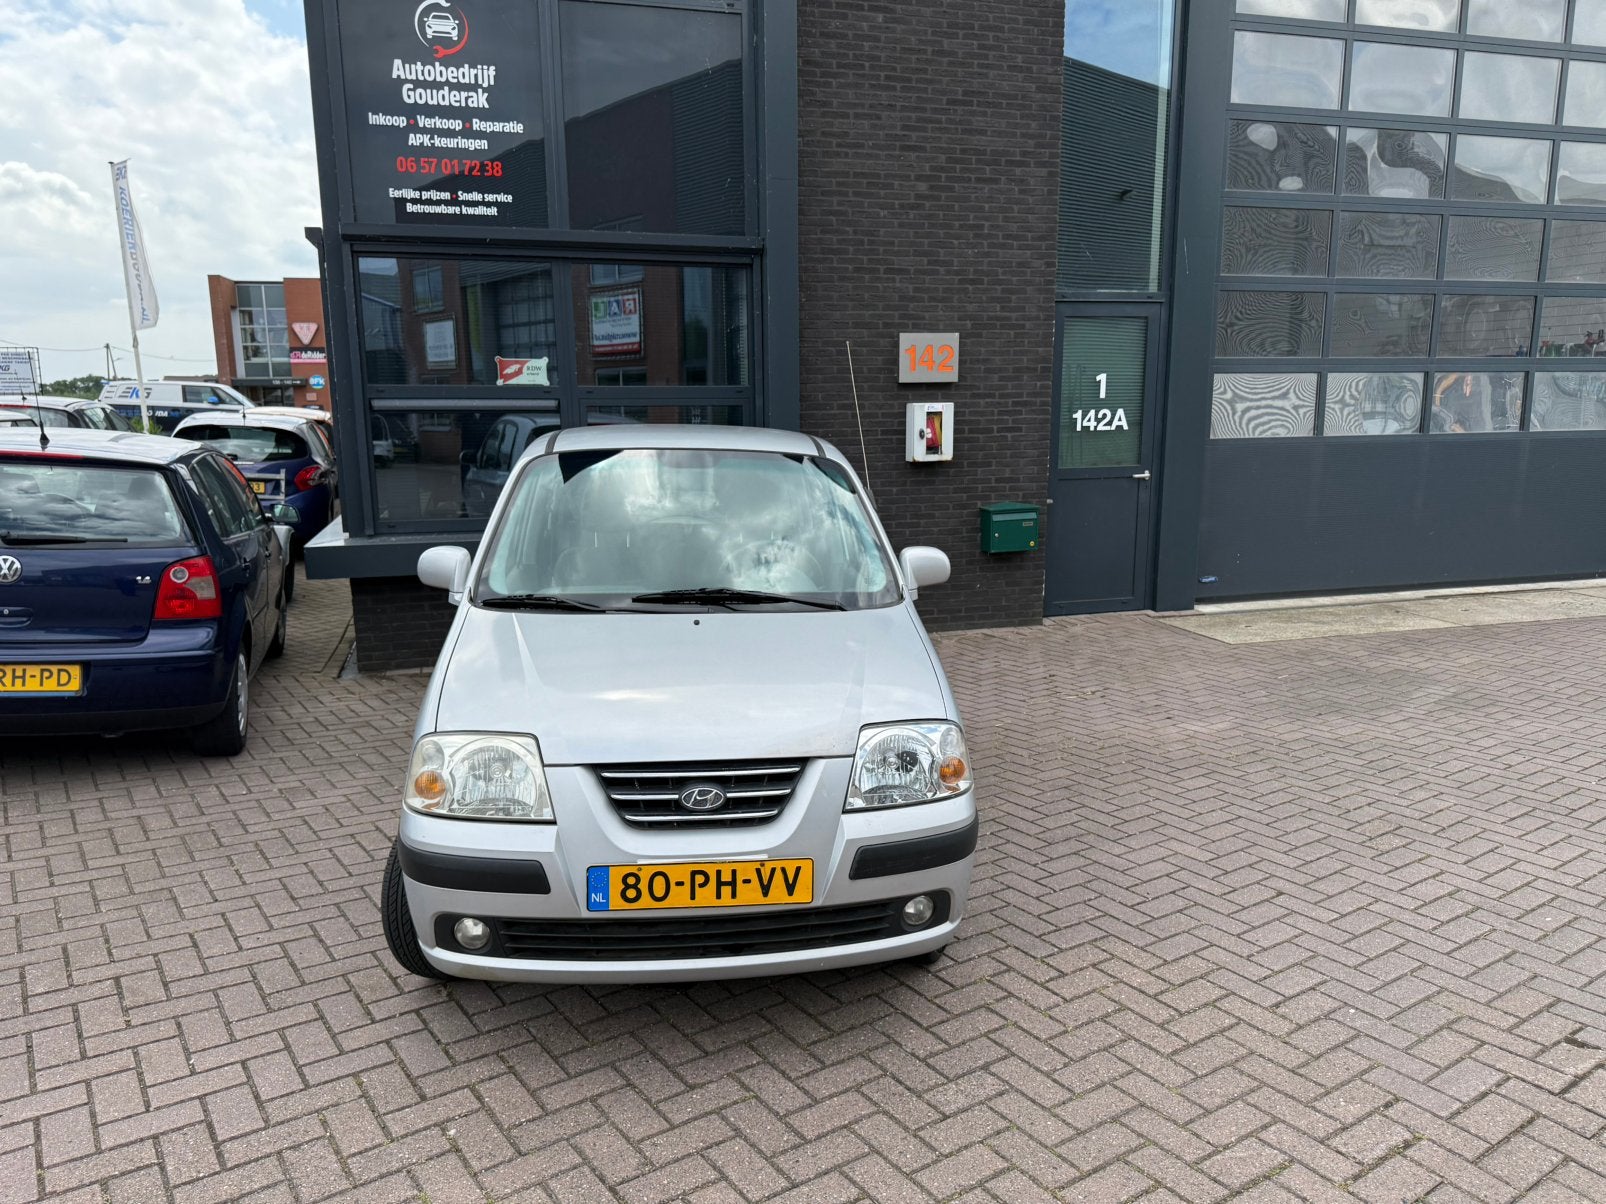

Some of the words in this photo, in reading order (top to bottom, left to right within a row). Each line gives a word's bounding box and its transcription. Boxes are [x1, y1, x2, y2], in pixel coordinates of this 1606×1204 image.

[392, 59, 496, 87] Autobedrijf
[402, 83, 489, 108] Gouderak
[368, 112, 407, 128] Inkoop
[416, 115, 463, 131] Verkoop
[472, 118, 524, 133] Reparatie
[408, 133, 488, 150] APK-keuringen
[396, 156, 417, 173] 06
[420, 157, 438, 174] 57
[441, 158, 459, 175] 01
[462, 159, 481, 176] 72
[484, 161, 503, 177] 38
[389, 188, 421, 199] Eerlijke
[421, 190, 451, 200] prijzen
[457, 191, 483, 202] Snelle
[483, 192, 513, 203] service
[406, 203, 460, 215] Betrouwbare
[461, 205, 498, 216] kwaliteit
[905, 344, 955, 373] 142
[1095, 373, 1108, 399] 1
[1072, 408, 1129, 431] 142A
[620, 865, 802, 904] 80-PH-VV
[591, 892, 606, 903] NL
